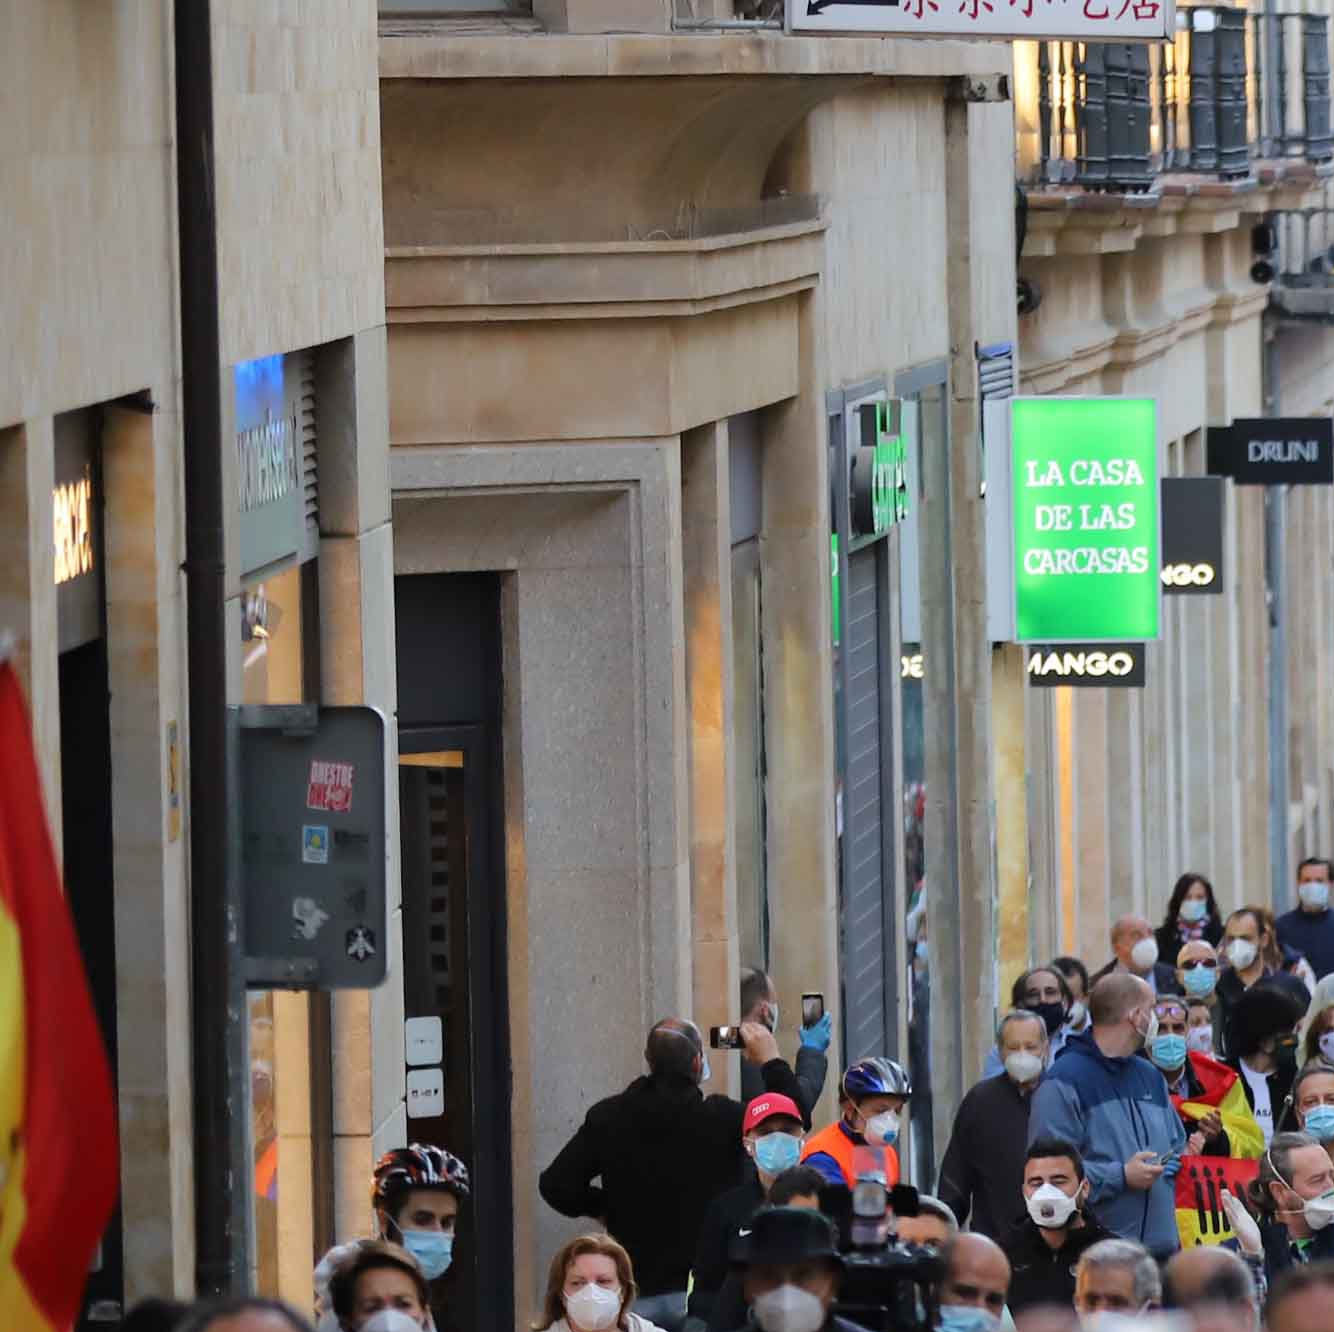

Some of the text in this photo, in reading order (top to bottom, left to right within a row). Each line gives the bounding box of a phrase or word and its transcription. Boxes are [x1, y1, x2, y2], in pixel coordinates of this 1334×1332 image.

[1247, 441, 1319, 462] DRUNI
[1026, 459, 1145, 487] LA CASA
[1035, 502, 1136, 531] DE LAS
[1024, 547, 1149, 575] CARCASAS
